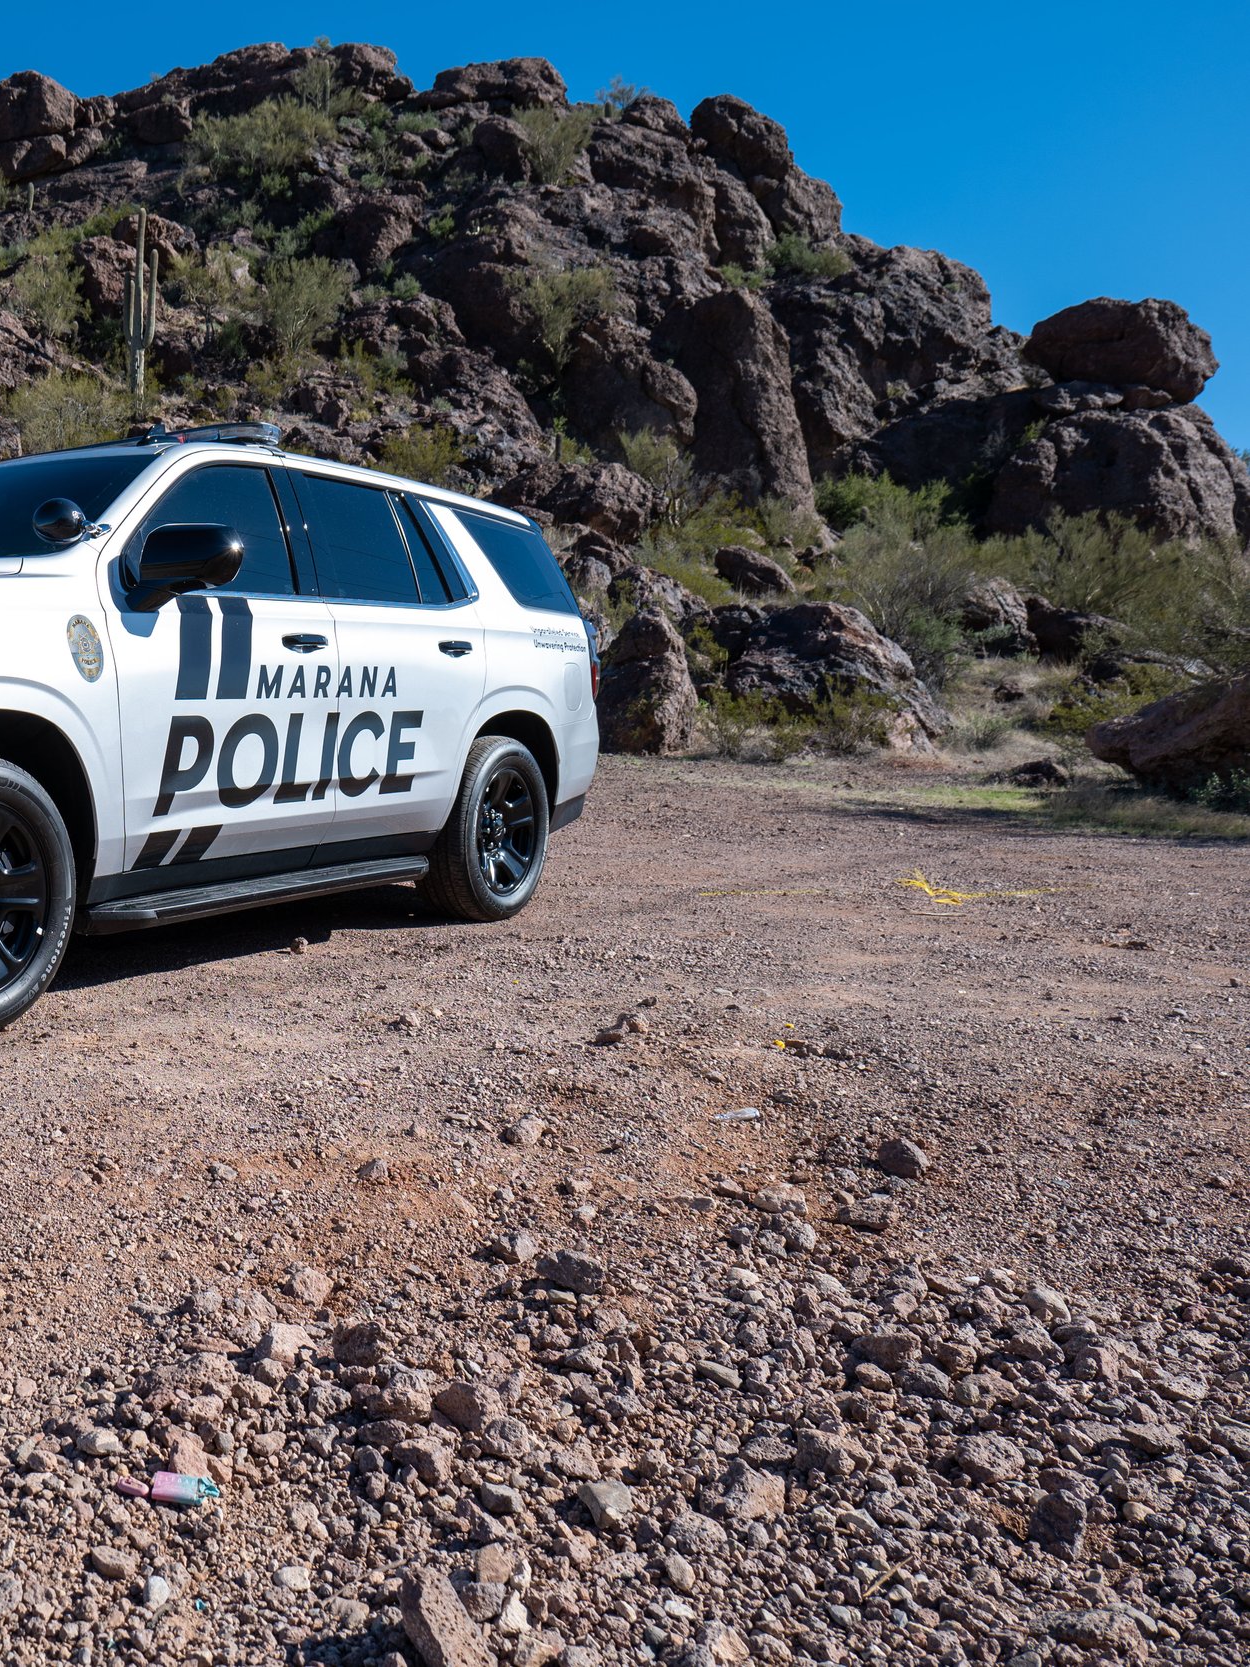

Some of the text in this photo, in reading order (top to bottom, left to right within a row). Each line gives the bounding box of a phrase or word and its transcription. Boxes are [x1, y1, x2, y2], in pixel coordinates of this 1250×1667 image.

[256, 664, 398, 699] MARANA
[152, 710, 424, 817] POLICE
[40, 904, 72, 982] Firestone
